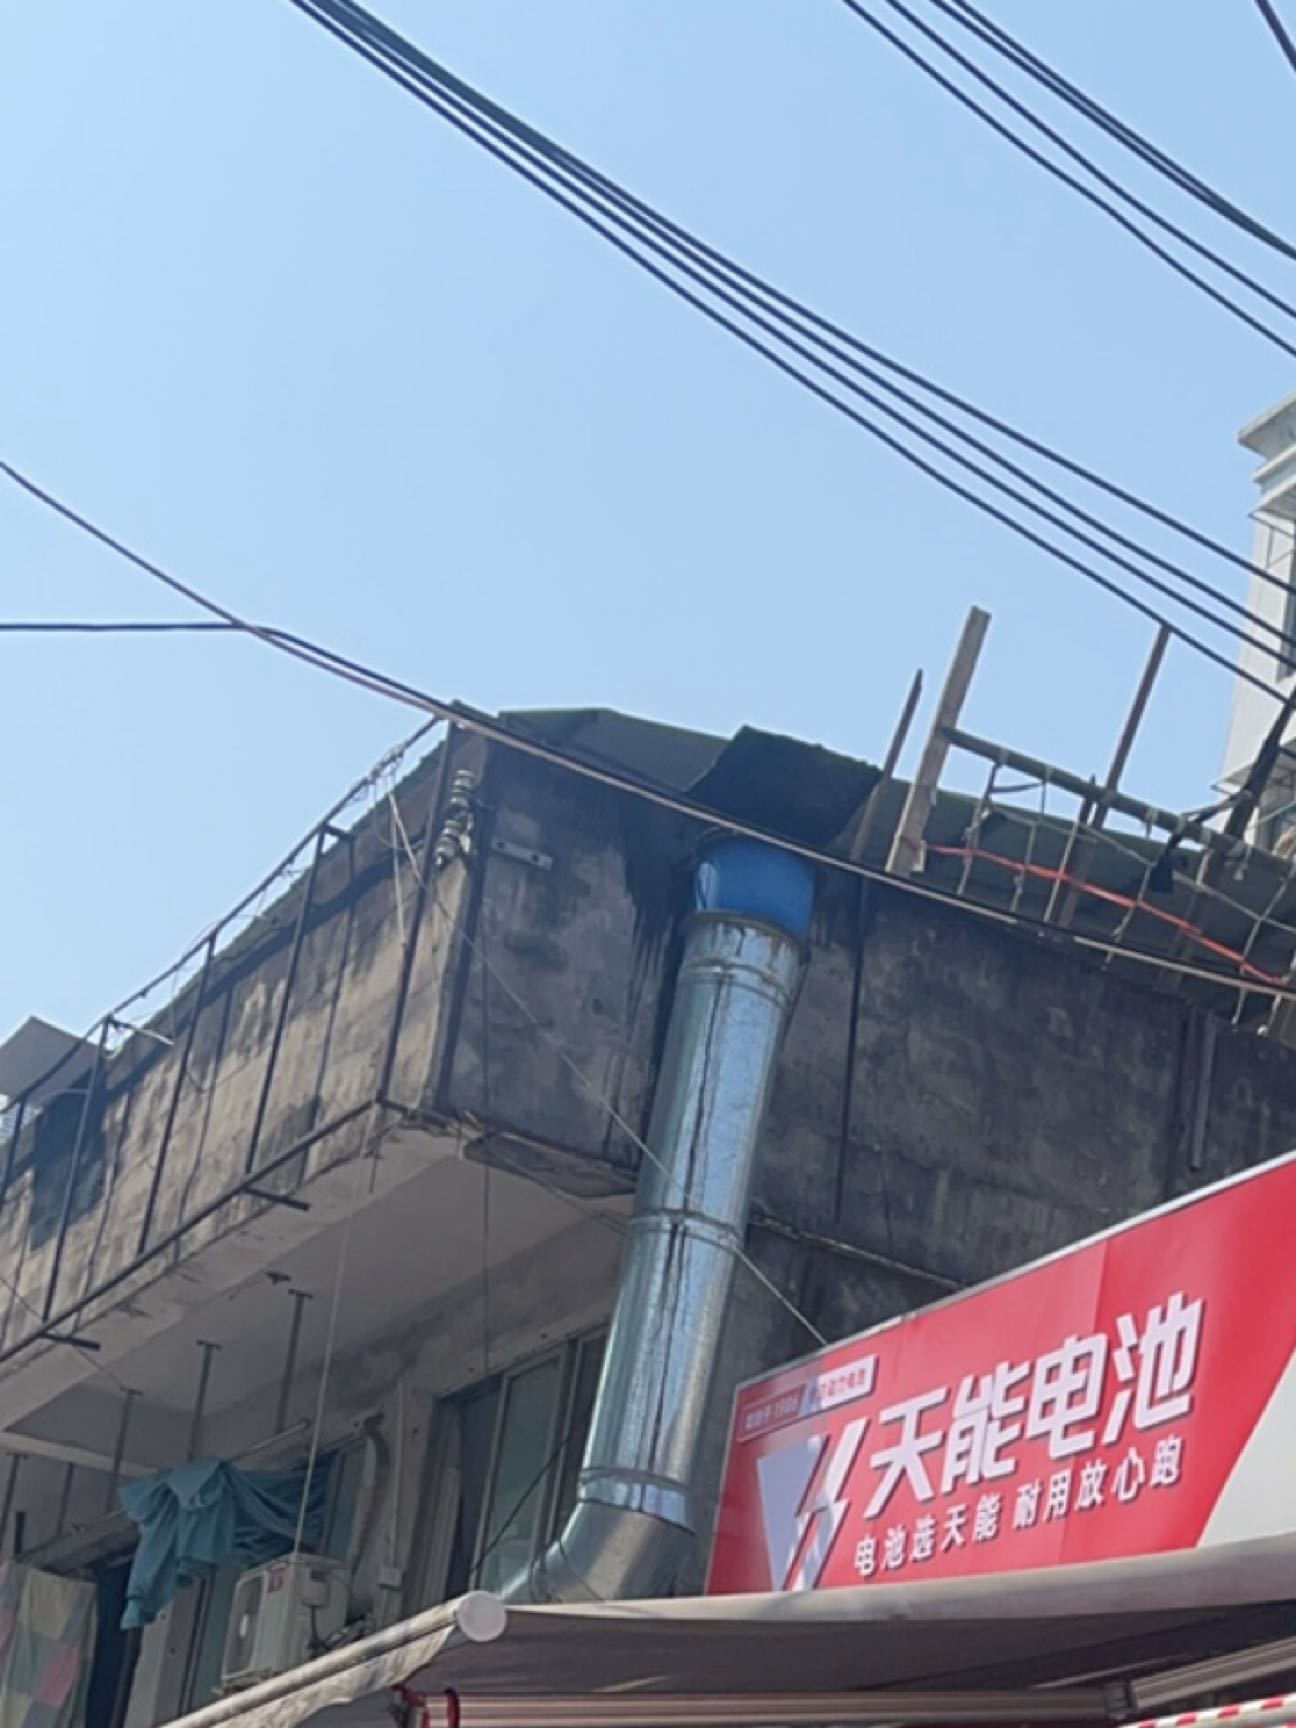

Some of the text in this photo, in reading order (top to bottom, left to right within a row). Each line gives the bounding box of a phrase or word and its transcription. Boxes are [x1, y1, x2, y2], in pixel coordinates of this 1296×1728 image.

[863, 1291, 1203, 1519] 天能电池
[853, 1434, 1185, 1577] 电池选天能 耐用放心跑
